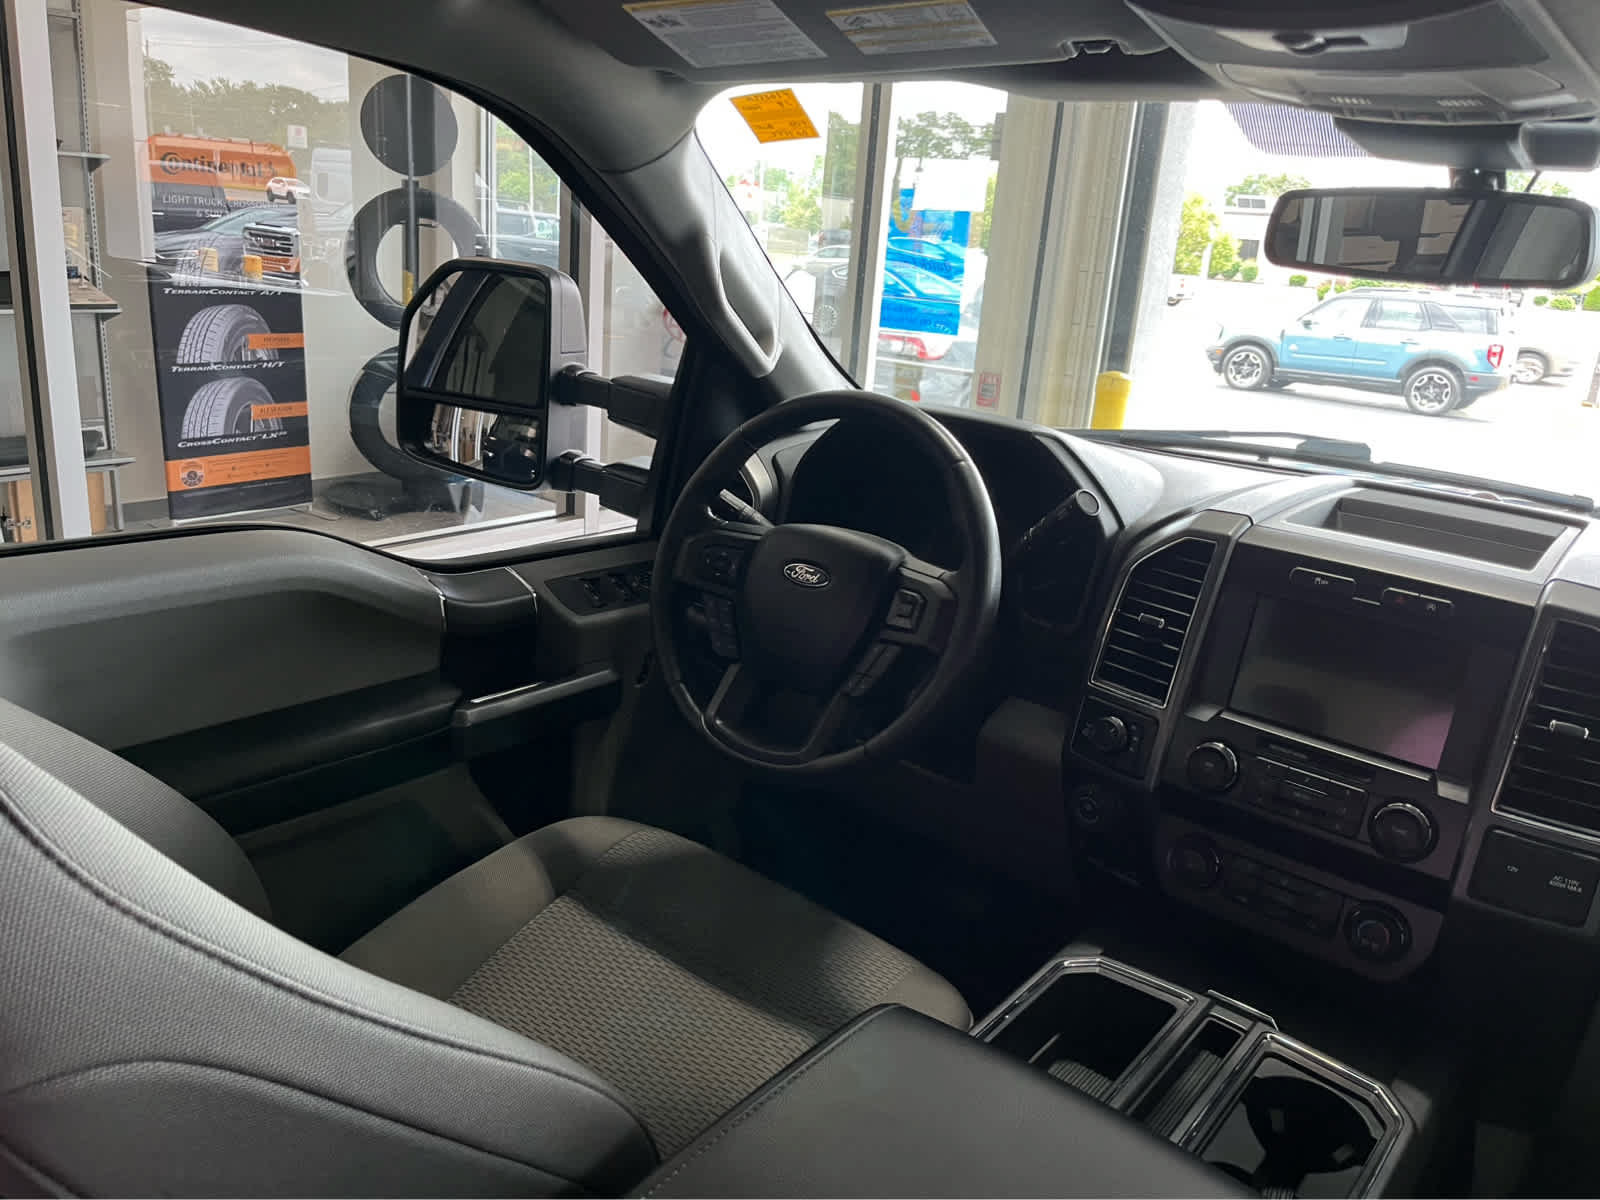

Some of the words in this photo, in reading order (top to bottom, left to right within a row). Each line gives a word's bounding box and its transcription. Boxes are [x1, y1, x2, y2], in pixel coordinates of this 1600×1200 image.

[161, 152, 263, 177] Continental
[162, 194, 190, 205] LIGHT
[262, 360, 286, 369] H/T
[791, 565, 820, 583] Ford
